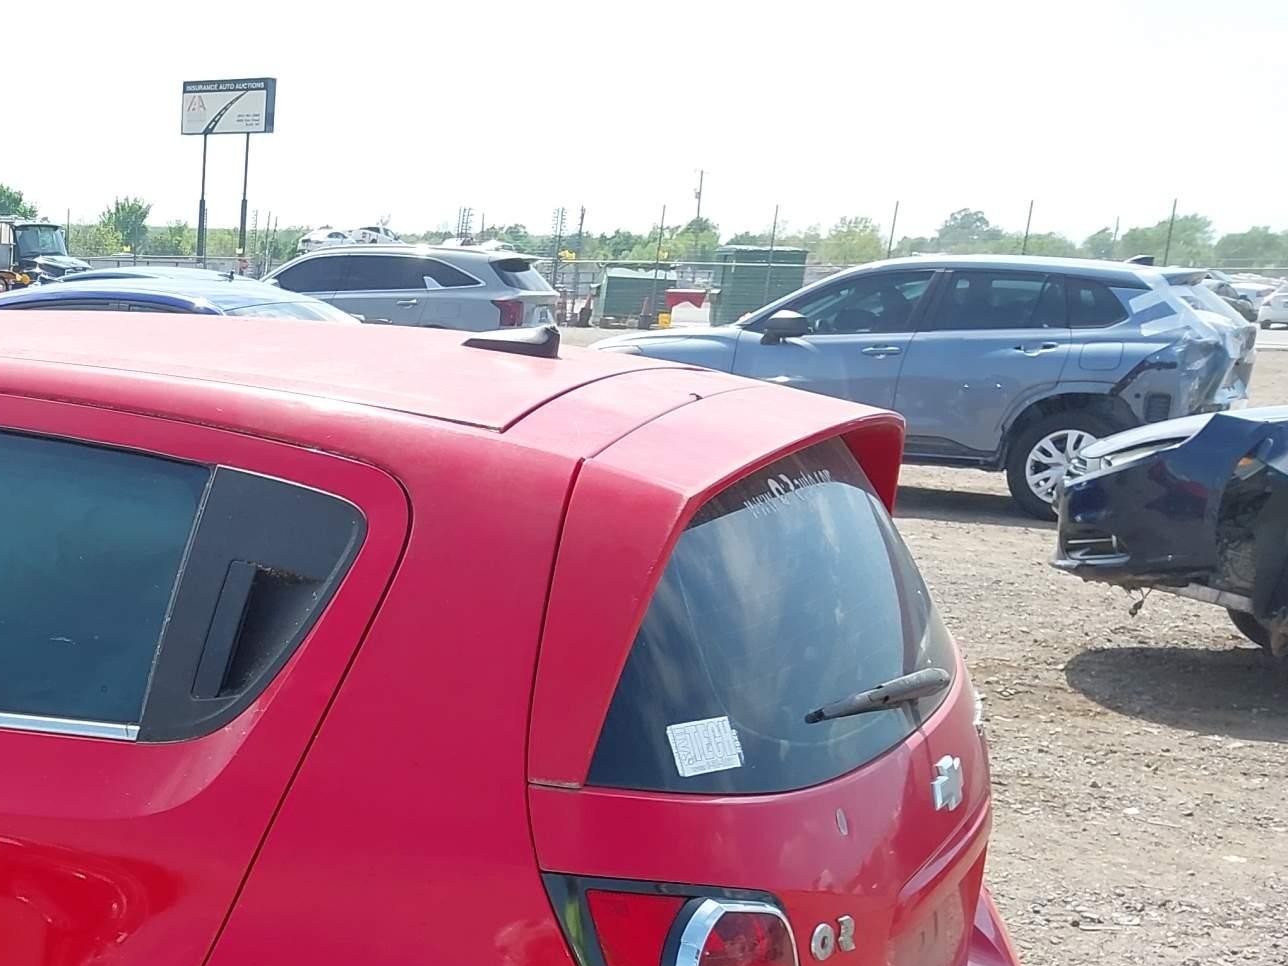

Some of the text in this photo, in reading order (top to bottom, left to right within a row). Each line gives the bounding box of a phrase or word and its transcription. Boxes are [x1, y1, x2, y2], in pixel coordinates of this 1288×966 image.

[185, 81, 265, 92] INSURANCE AUTO AUCTIONS
